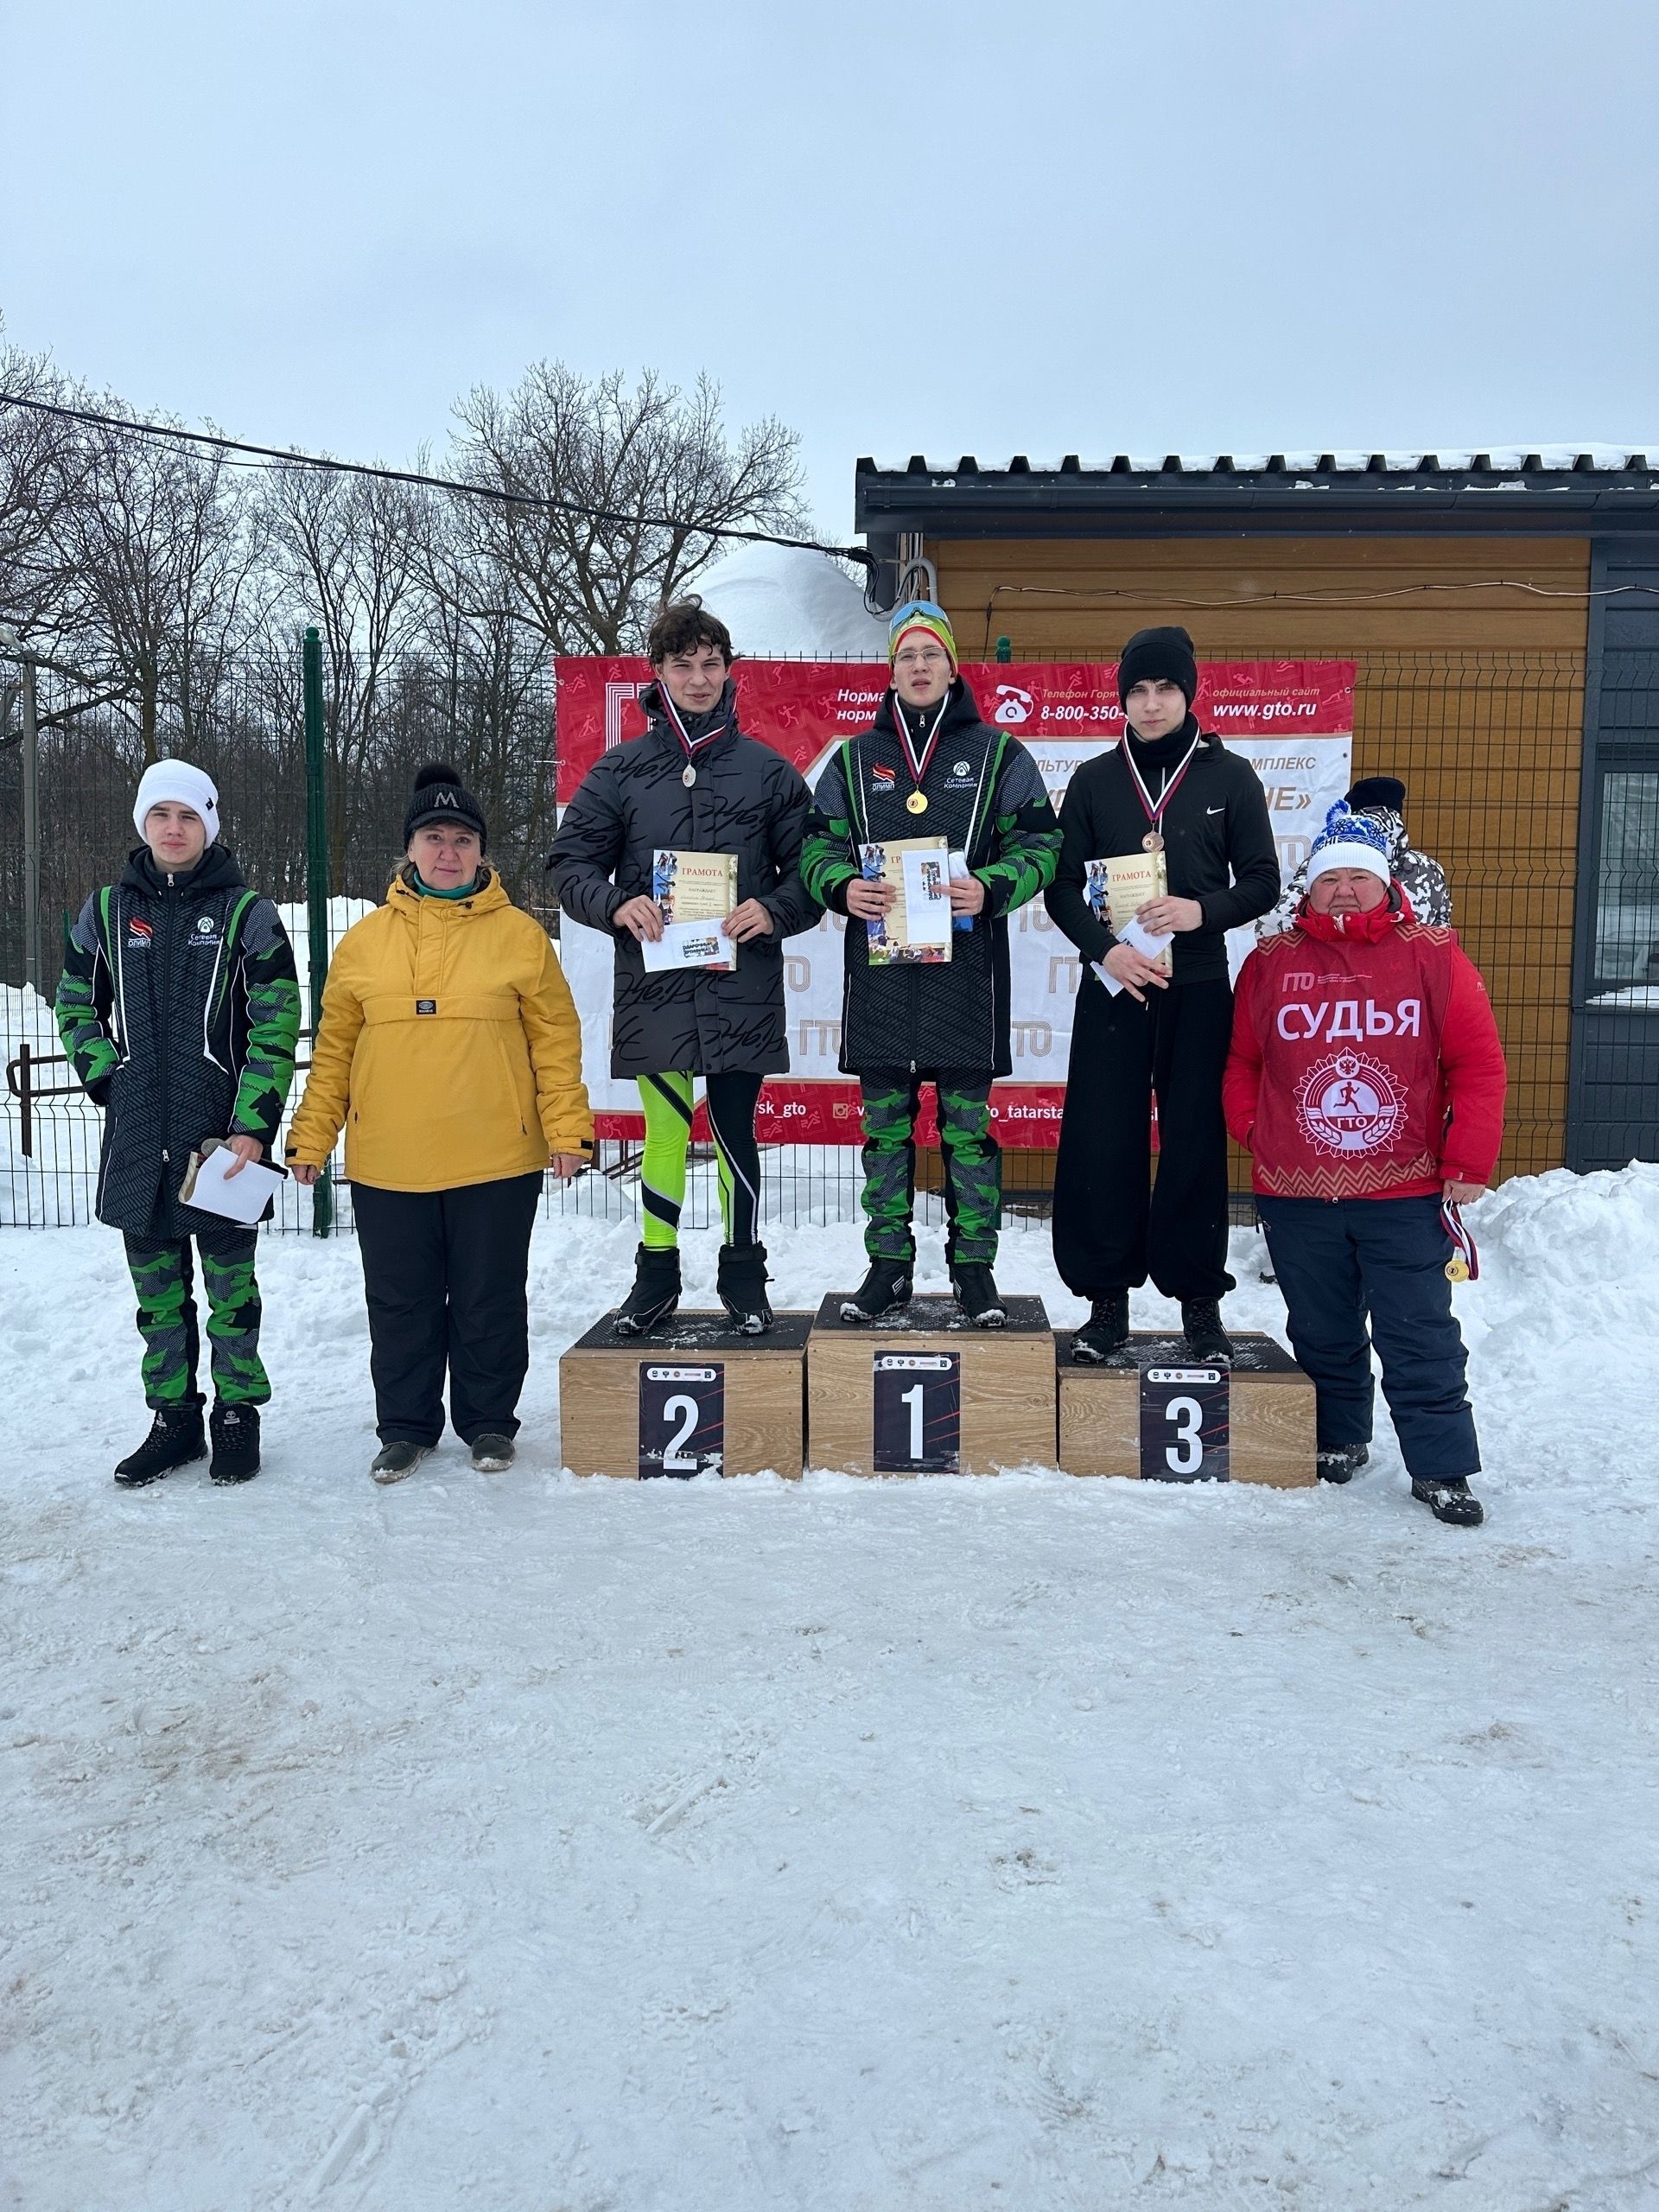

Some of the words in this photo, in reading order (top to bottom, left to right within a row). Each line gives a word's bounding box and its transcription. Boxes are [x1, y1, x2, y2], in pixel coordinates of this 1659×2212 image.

[1043, 690, 1088, 700] Телефон
[1212, 687, 1289, 699] официальный
[1292, 687, 1320, 696] сайт
[836, 710, 877, 724] норм
[1040, 705, 1128, 720] 8-800-350-
[1213, 701, 1317, 720] www.gto.ru
[434, 791, 459, 809] M
[682, 868, 723, 877] ГРАМОТА
[1112, 870, 1152, 882] ГРАМОТА
[1281, 972, 1315, 993] ГТО
[1277, 999, 1421, 1043] СУДЬЯ
[756, 1100, 806, 1118] sk_gto
[1337, 1116, 1368, 1128] ГТО
[901, 1384, 924, 1459] 1
[663, 1394, 699, 1470] 2
[1165, 1396, 1204, 1474] 3
